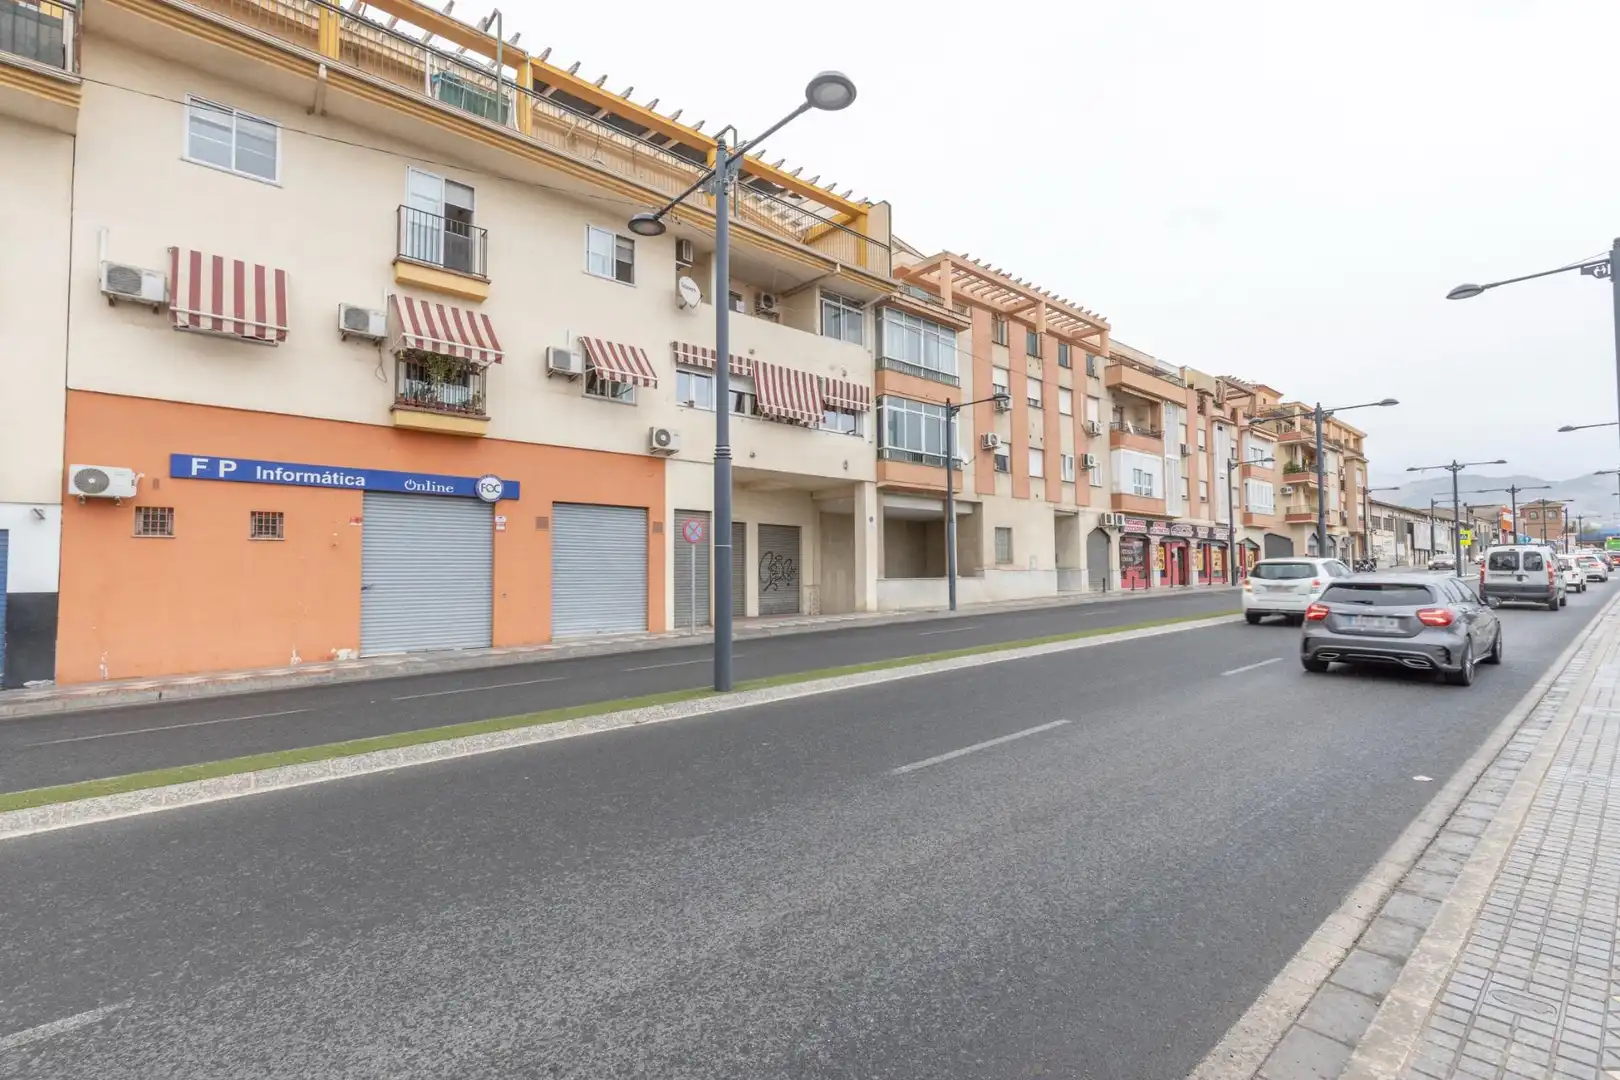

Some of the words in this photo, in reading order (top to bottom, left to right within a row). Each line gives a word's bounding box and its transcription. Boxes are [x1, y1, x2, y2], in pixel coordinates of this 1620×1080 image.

[191, 457, 209, 476] F
[218, 459, 237, 478] P
[256, 465, 366, 487] Informática
[404, 479, 454, 493] Online
[480, 482, 501, 494] FOC
